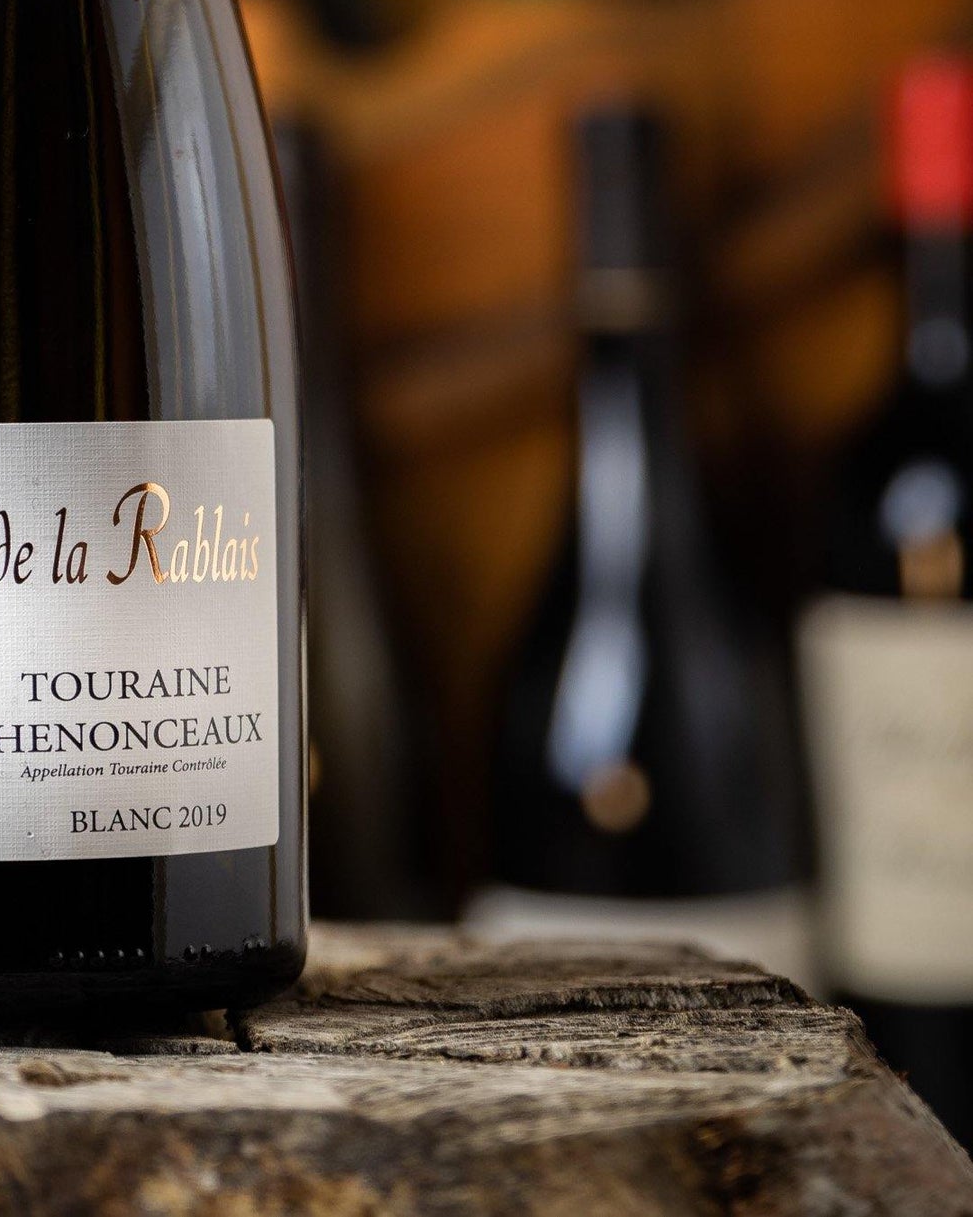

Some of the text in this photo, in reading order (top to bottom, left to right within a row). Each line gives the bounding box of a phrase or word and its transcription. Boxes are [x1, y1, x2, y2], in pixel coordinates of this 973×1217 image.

[51, 507, 89, 585] la
[106, 482, 260, 585] Rablais
[21, 666, 231, 703] TOURAINE
[21, 757, 227, 781] Appellation Touraine Contrôlée
[70, 804, 227, 834] BLANC 2019
